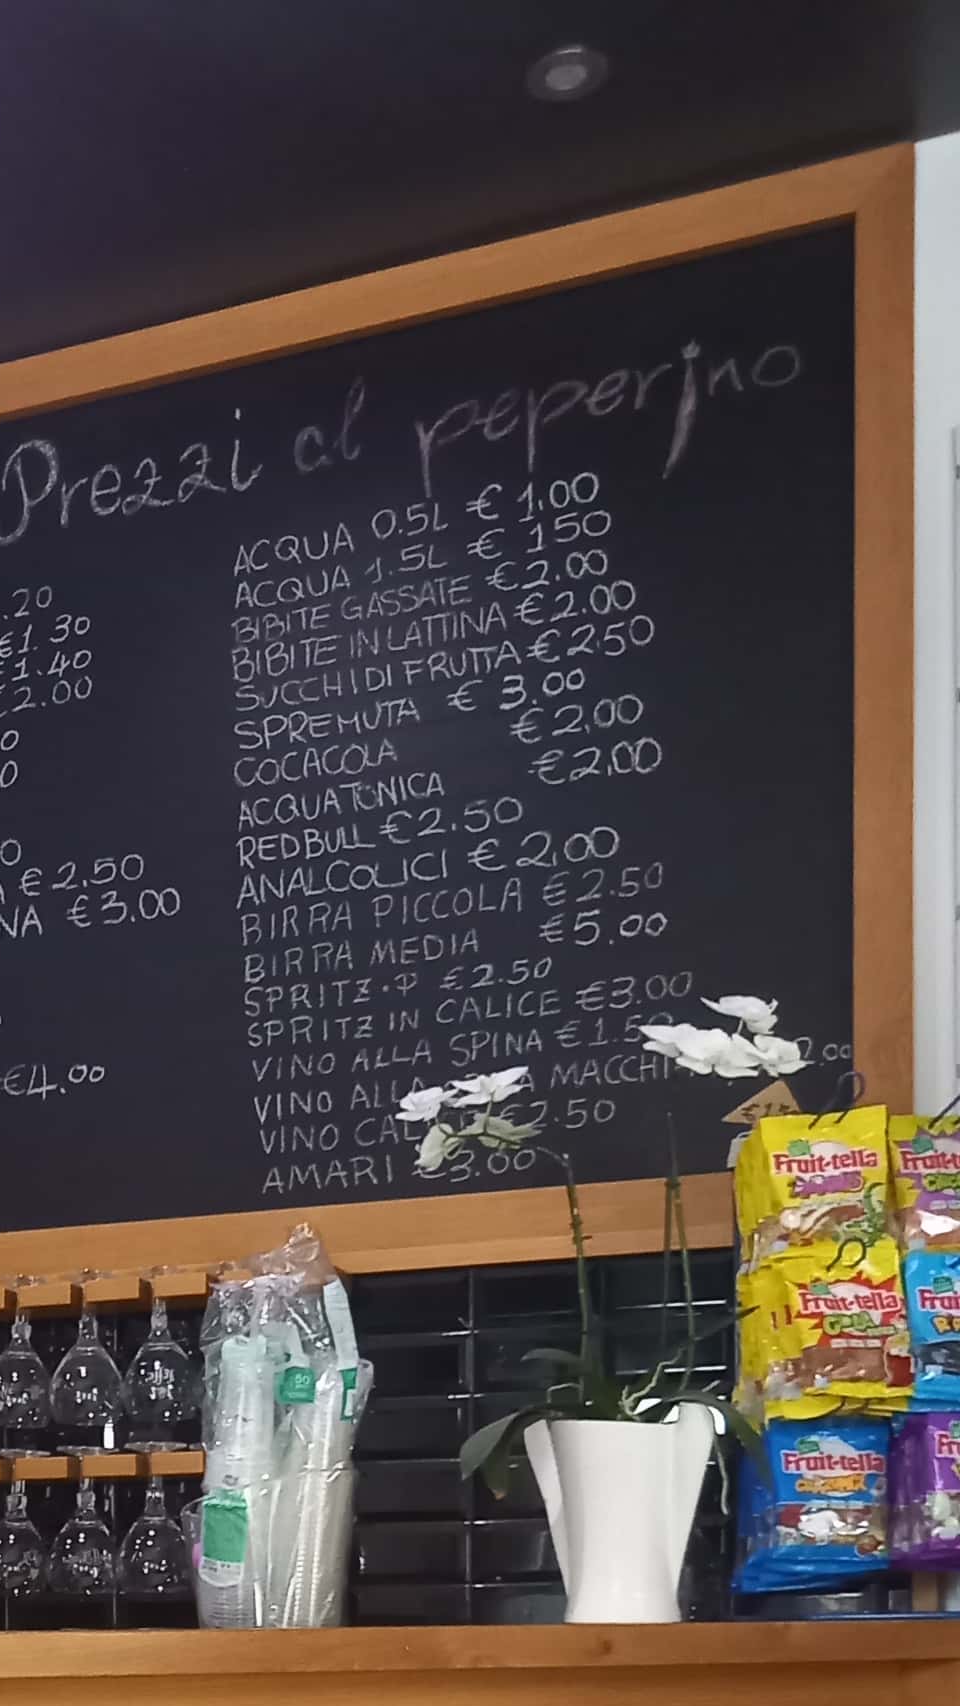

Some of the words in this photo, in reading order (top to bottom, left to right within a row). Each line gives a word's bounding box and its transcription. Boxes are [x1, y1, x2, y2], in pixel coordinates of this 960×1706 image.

[293, 376, 365, 473] al
[234, 522, 355, 577] ACQUA
[371, 503, 449, 540] 0.5L
[234, 564, 351, 608] ACQUA
[365, 544, 448, 584] 1.5L
[231, 603, 332, 643] BIBITE
[341, 575, 472, 620] GASSATE
[232, 634, 342, 682] BIBITE
[235, 668, 358, 711] SUCCHI
[402, 640, 521, 685] FRUTTA
[234, 698, 420, 749] SPREMUTA
[234, 738, 397, 787] COCACOLA
[237, 849, 447, 909] ANALCOLICI
[240, 900, 352, 946] BIRRA
[372, 878, 521, 927] PICCOLA
[244, 941, 353, 983] BIRRA
[371, 929, 478, 965] MEDIA
[248, 1015, 373, 1047] SPRITZ
[389, 1009, 419, 1032] IN
[436, 990, 560, 1023] CALICE
[253, 1053, 336, 1082] VINO
[352, 1039, 432, 1072] ALLA
[449, 1029, 543, 1067] SPINA
[254, 1091, 333, 1125] VINO
[260, 1124, 339, 1155] VINO
[773, 1148, 879, 1173] Fruit-tella
[262, 1154, 394, 1194] AMARI
[799, 1292, 899, 1312] Fruit-tella
[783, 1452, 885, 1472] Fruit-tella
